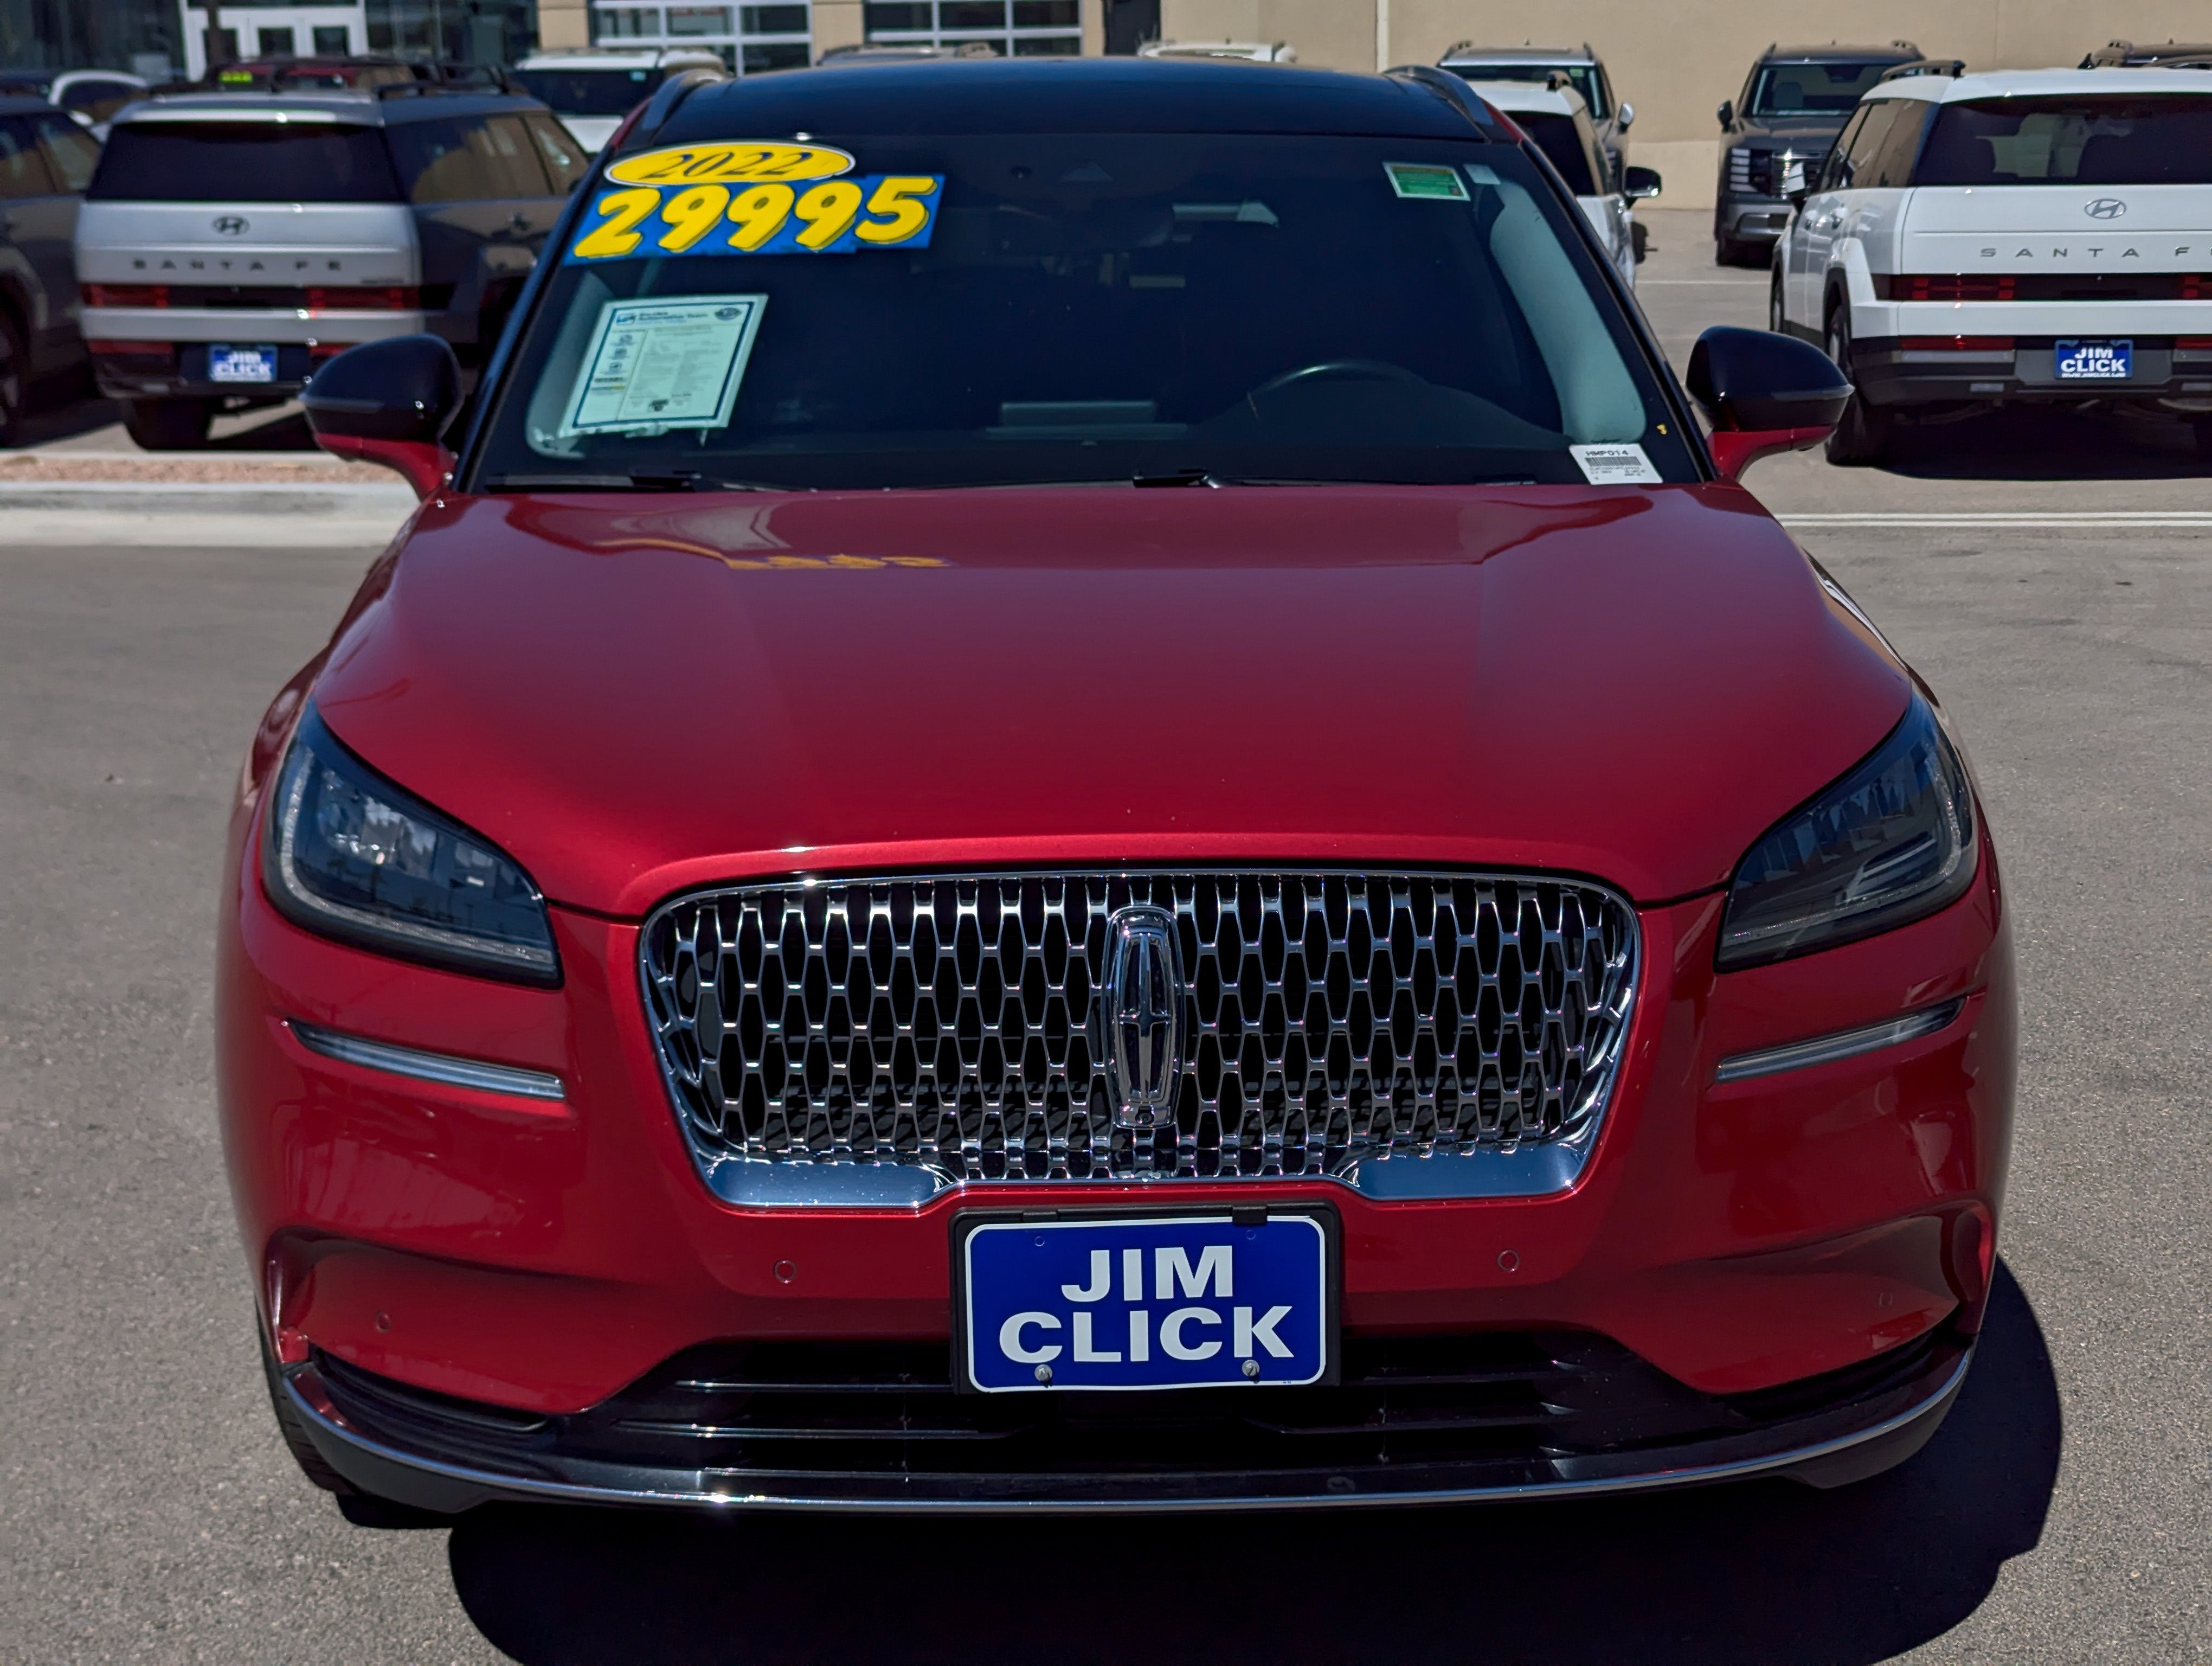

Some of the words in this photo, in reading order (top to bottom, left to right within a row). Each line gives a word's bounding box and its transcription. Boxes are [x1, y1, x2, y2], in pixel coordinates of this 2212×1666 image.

[638, 151, 813, 179] 2022
[574, 176, 937, 258] 29995
[1980, 247, 2139, 258] SANTA
[2174, 246, 2212, 257] F
[132, 258, 265, 271] SANTA
[294, 259, 342, 271] FE
[2074, 347, 2113, 358] JIM
[2061, 359, 2125, 372] CLICK
[1061, 1246, 1233, 1302] JIM
[999, 1306, 1294, 1363] CLICK
